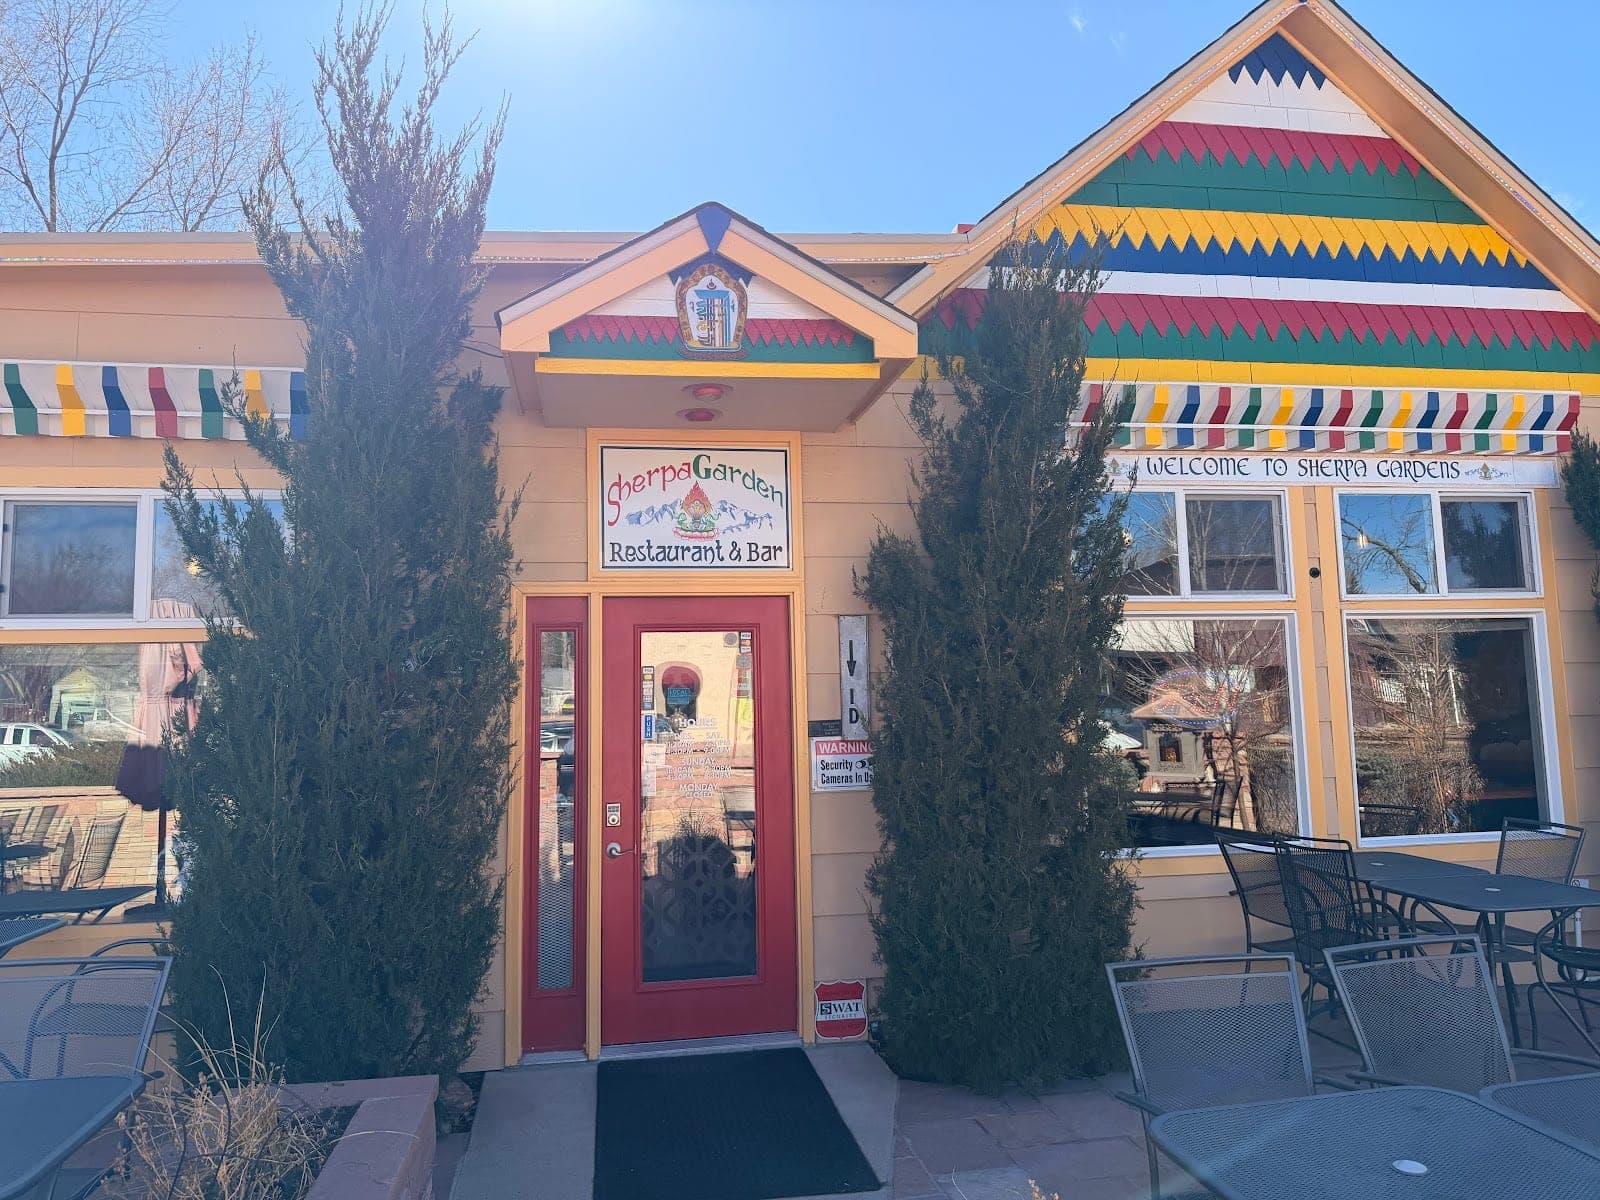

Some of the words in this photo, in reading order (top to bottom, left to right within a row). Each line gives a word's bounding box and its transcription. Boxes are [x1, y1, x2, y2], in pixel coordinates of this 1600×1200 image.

[1146, 457, 1250, 476] WELCOME
[1263, 458, 1288, 477] TO
[1298, 458, 1367, 482] SHERPA
[1376, 460, 1460, 482] GARDENS
[607, 462, 692, 526] Sherpa
[692, 454, 784, 508] Garden
[609, 539, 725, 564] Restaurant
[728, 541, 742, 562] &
[746, 542, 783, 562] Bar
[679, 717, 717, 727] HOURS
[681, 757, 715, 765] SUNDAY
[820, 759, 853, 772] Security
[821, 773, 853, 785] Cameras
[855, 772, 863, 783] In
[679, 783, 719, 791] MONDAY
[820, 1002, 859, 1015] SWAT
